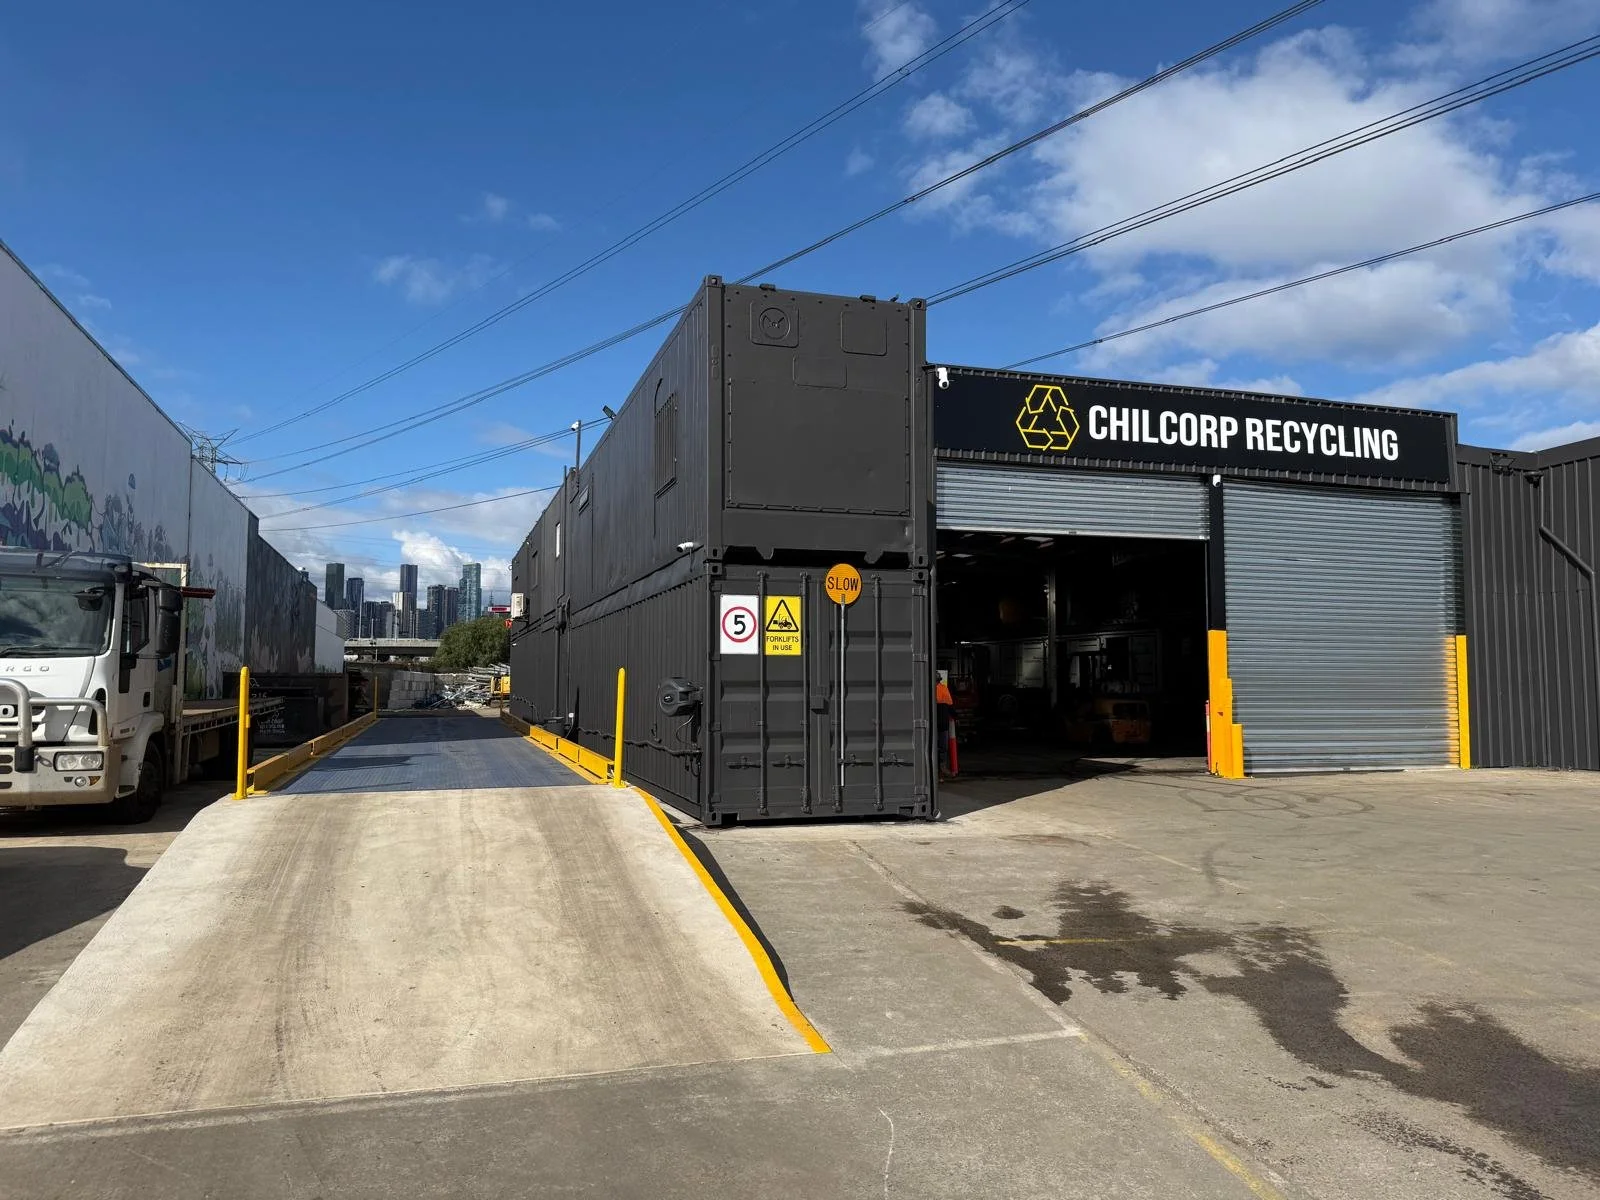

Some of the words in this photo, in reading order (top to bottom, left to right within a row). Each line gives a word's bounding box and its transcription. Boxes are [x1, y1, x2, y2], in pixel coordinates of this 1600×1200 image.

[1088, 405, 1238, 448] CHILCORP
[1245, 418, 1399, 461] RECYCLING
[827, 576, 859, 591] SLOW
[734, 614, 746, 635] 5
[766, 635, 799, 643] FORKLIFTS
